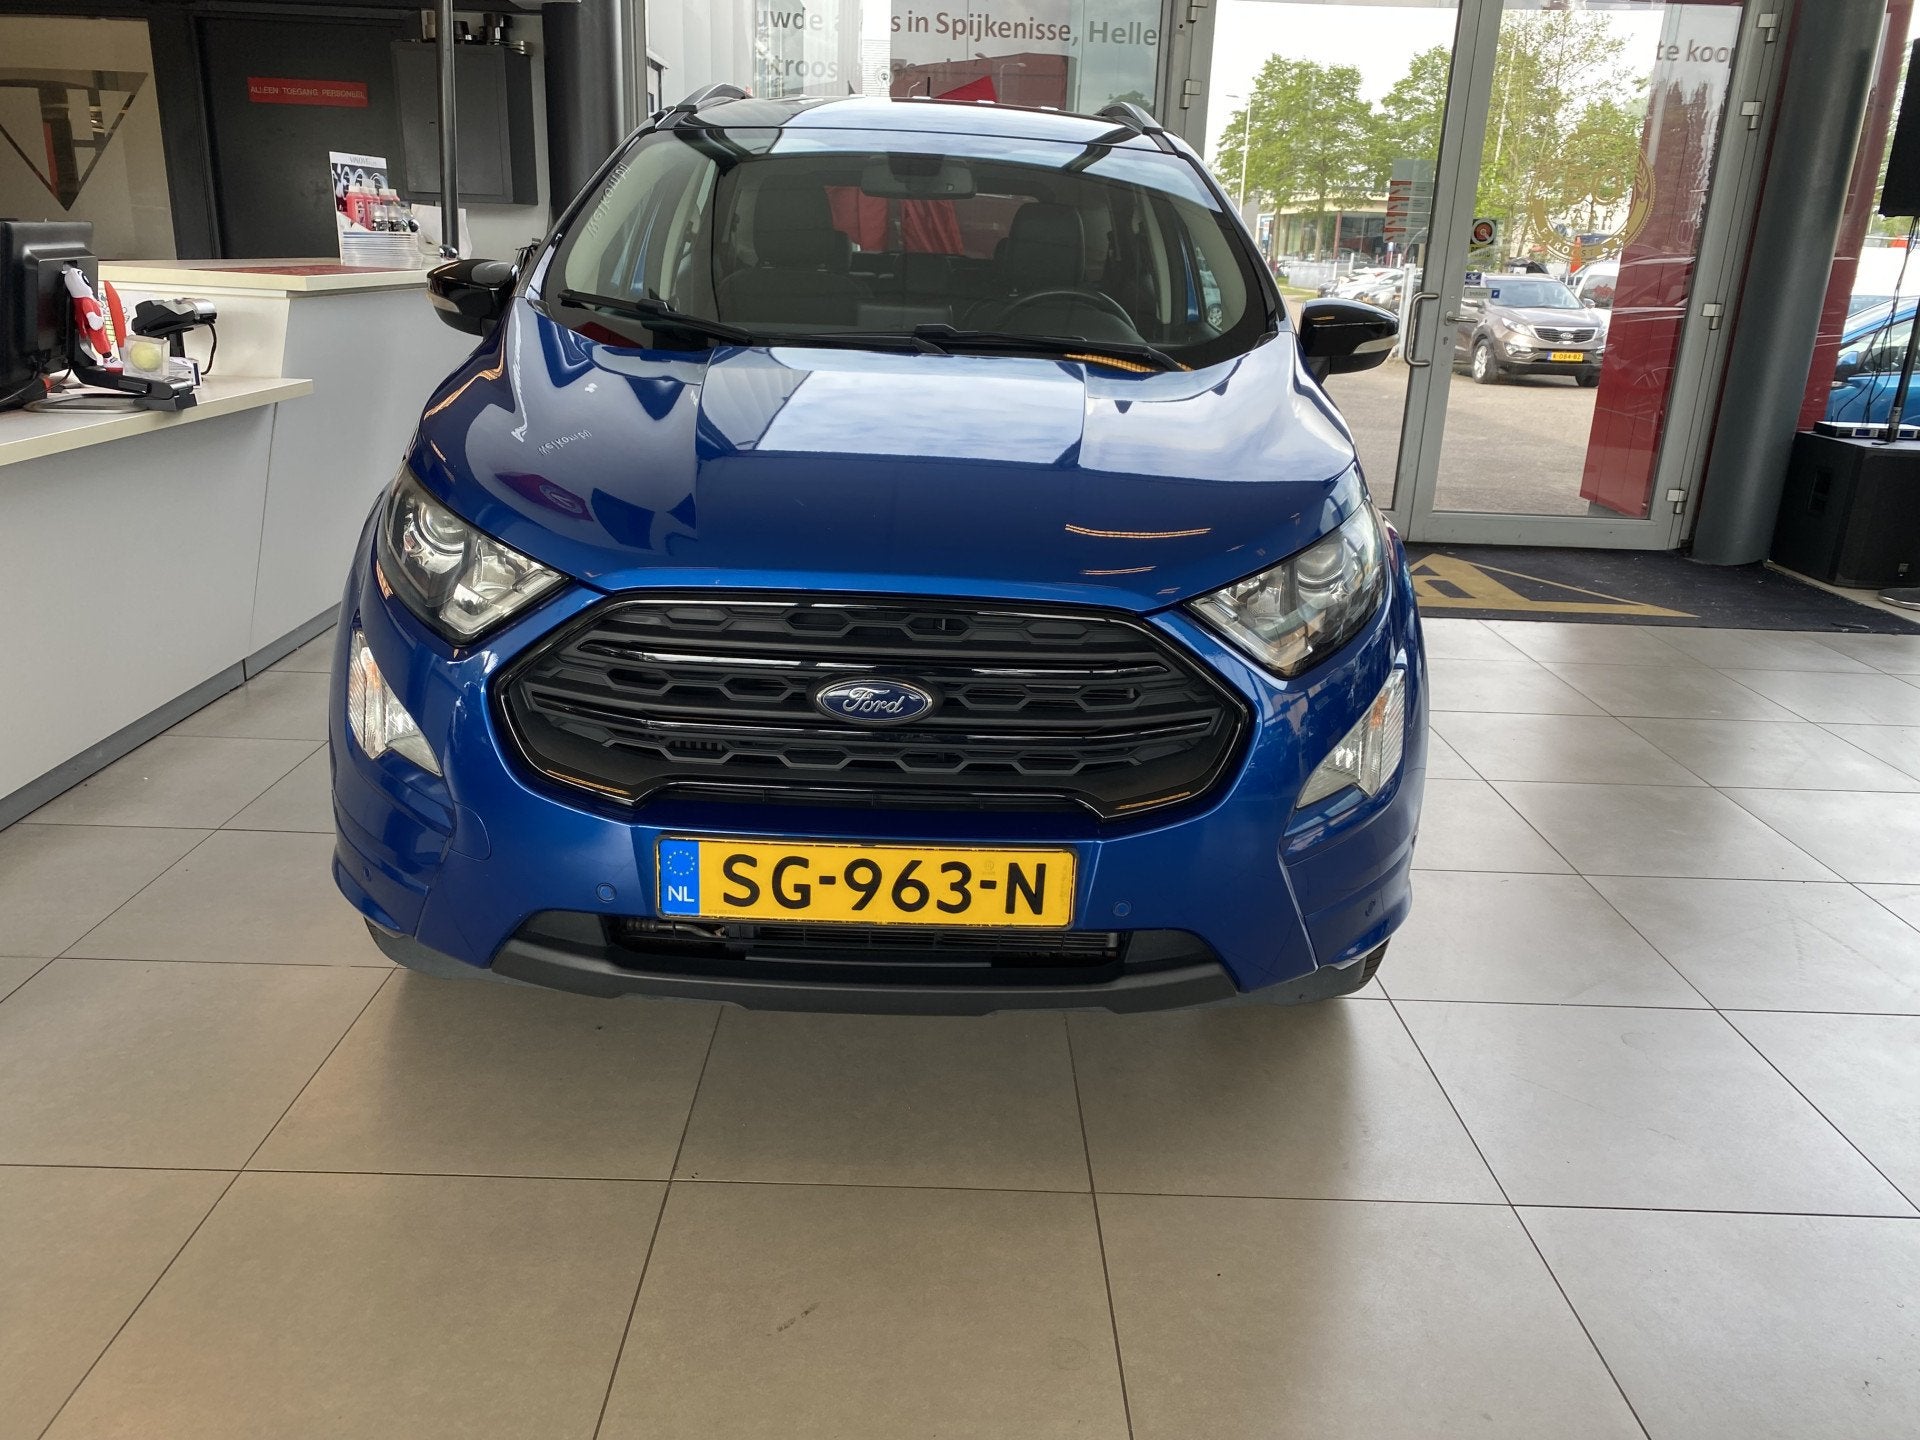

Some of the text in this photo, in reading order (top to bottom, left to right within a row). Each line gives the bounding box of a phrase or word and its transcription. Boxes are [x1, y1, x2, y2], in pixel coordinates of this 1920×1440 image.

[908, 10, 929, 33] in
[935, 12, 1079, 47] Spijkenisse,
[1656, 40, 1679, 61] te
[250, 86, 366, 98] ALLEEN TOEGANG PERSONEEL
[843, 687, 905, 713] Ford
[668, 885, 695, 903] NL
[722, 854, 1047, 916] SG-963-N
